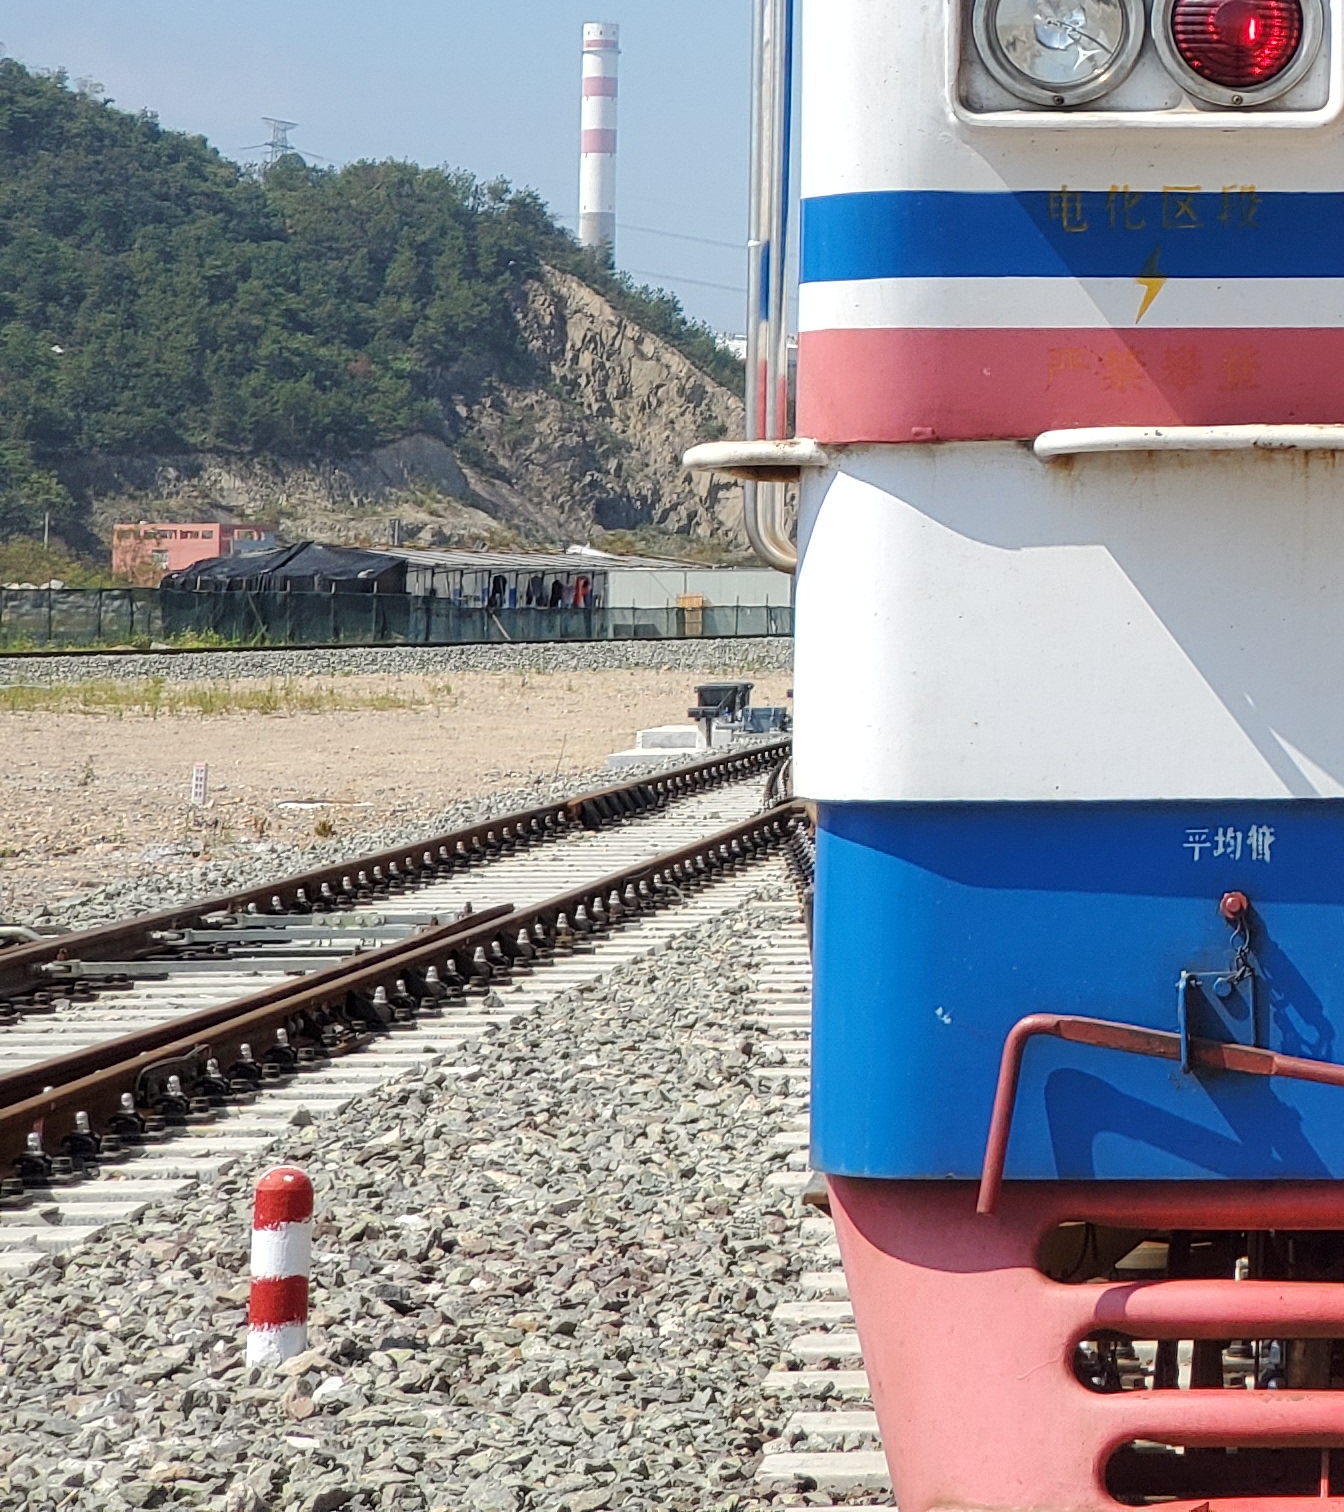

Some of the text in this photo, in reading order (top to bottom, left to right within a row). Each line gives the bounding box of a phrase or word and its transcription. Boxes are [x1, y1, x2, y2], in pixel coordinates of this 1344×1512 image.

[1047, 183, 1263, 233] 电化区段
[1182, 824, 1276, 864] 平均管
